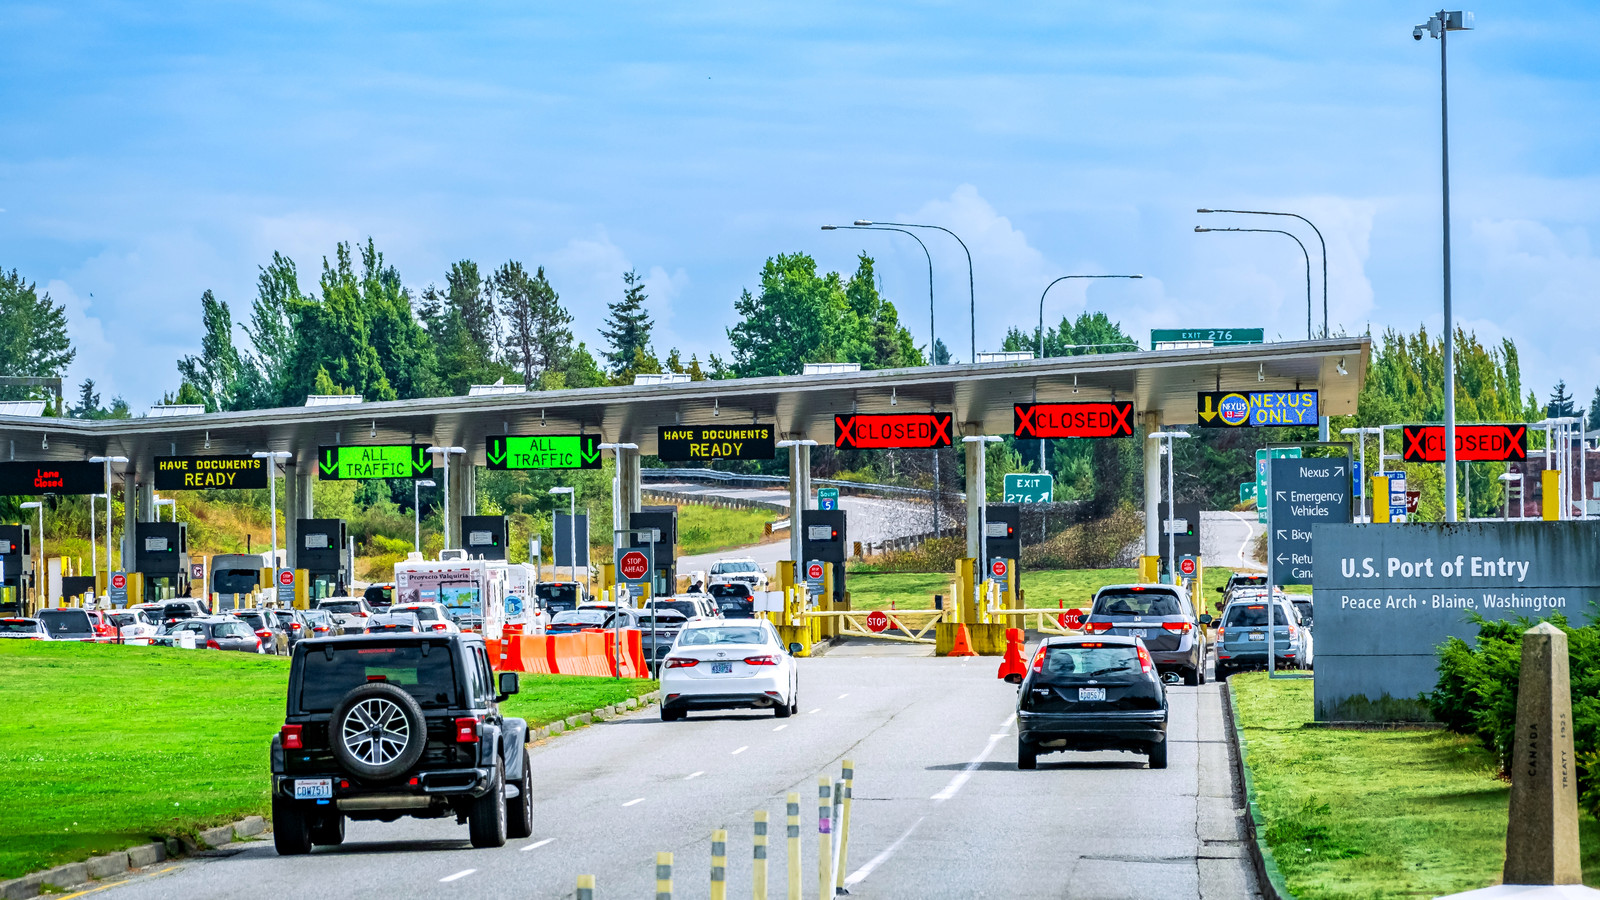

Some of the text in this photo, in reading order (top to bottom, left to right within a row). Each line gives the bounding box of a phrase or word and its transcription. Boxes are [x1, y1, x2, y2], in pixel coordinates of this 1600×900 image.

[1208, 331, 1233, 340] 276
[1250, 393, 1313, 408] NEXUS
[1036, 411, 1110, 429] CLOSED
[1256, 408, 1306, 424] ONLY
[664, 429, 769, 441] HAVE DOCUMENTS
[856, 422, 930, 440] CLOSED
[529, 439, 557, 452] ALL
[1427, 435, 1502, 451] CLOSED
[362, 448, 388, 461] ALL
[690, 443, 743, 457] READY
[159, 458, 261, 471] HAVE DOCUMENTS
[513, 453, 573, 466] TRAFFIC
[37, 469, 60, 479] Lane
[346, 463, 405, 476] TRAFFIC
[1299, 466, 1330, 478] Nexus
[34, 478, 64, 489] Closed
[184, 473, 236, 487] READY
[1017, 479, 1041, 488] EXIT
[1007, 494, 1033, 503] 276
[1290, 491, 1344, 508] Emergency
[825, 501, 832, 511] 5
[1290, 505, 1329, 517] Vehicles
[627, 557, 642, 565] STOP
[623, 565, 645, 573] AHEAD
[1341, 556, 1530, 583] U.S. Port of Entry
[409, 573, 469, 581] Proyecto Valquiria
[1341, 593, 1566, 612] Peace Arch Blaine, Washington
[868, 617, 887, 626] STOP
[1065, 614, 1079, 624] STO
[1528, 723, 1538, 777] CANADA
